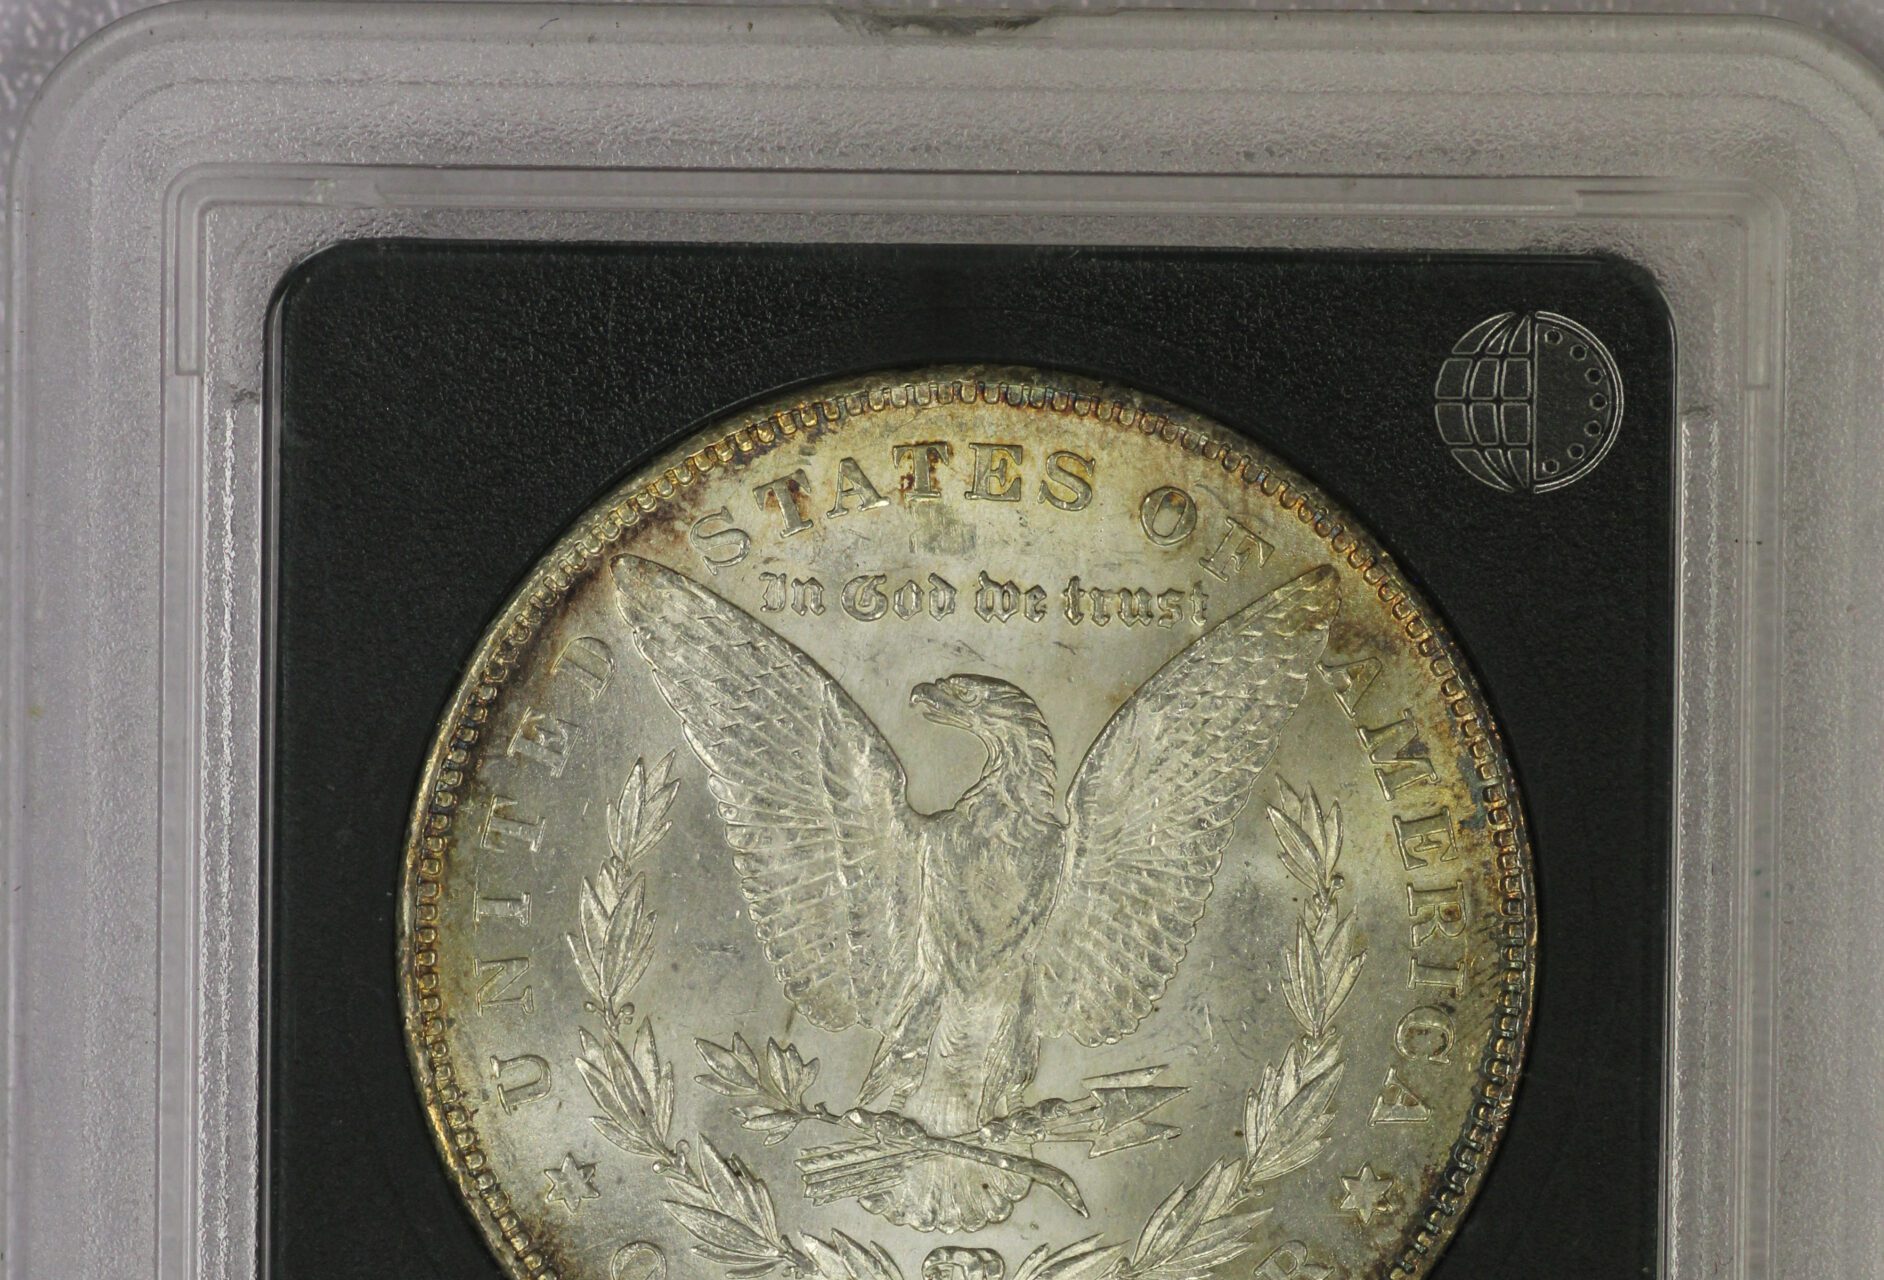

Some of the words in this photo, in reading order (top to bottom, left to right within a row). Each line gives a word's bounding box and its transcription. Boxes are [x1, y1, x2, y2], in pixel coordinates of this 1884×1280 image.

[472, 635, 618, 1117] UNITED
[688, 440, 1096, 576] STATES
[1138, 486, 1276, 583] OF
[1315, 656, 1468, 1128] AMERICA
[759, 571, 826, 617] In
[840, 572, 958, 623] God
[973, 570, 1048, 624] we
[1061, 574, 1209, 630] trust
